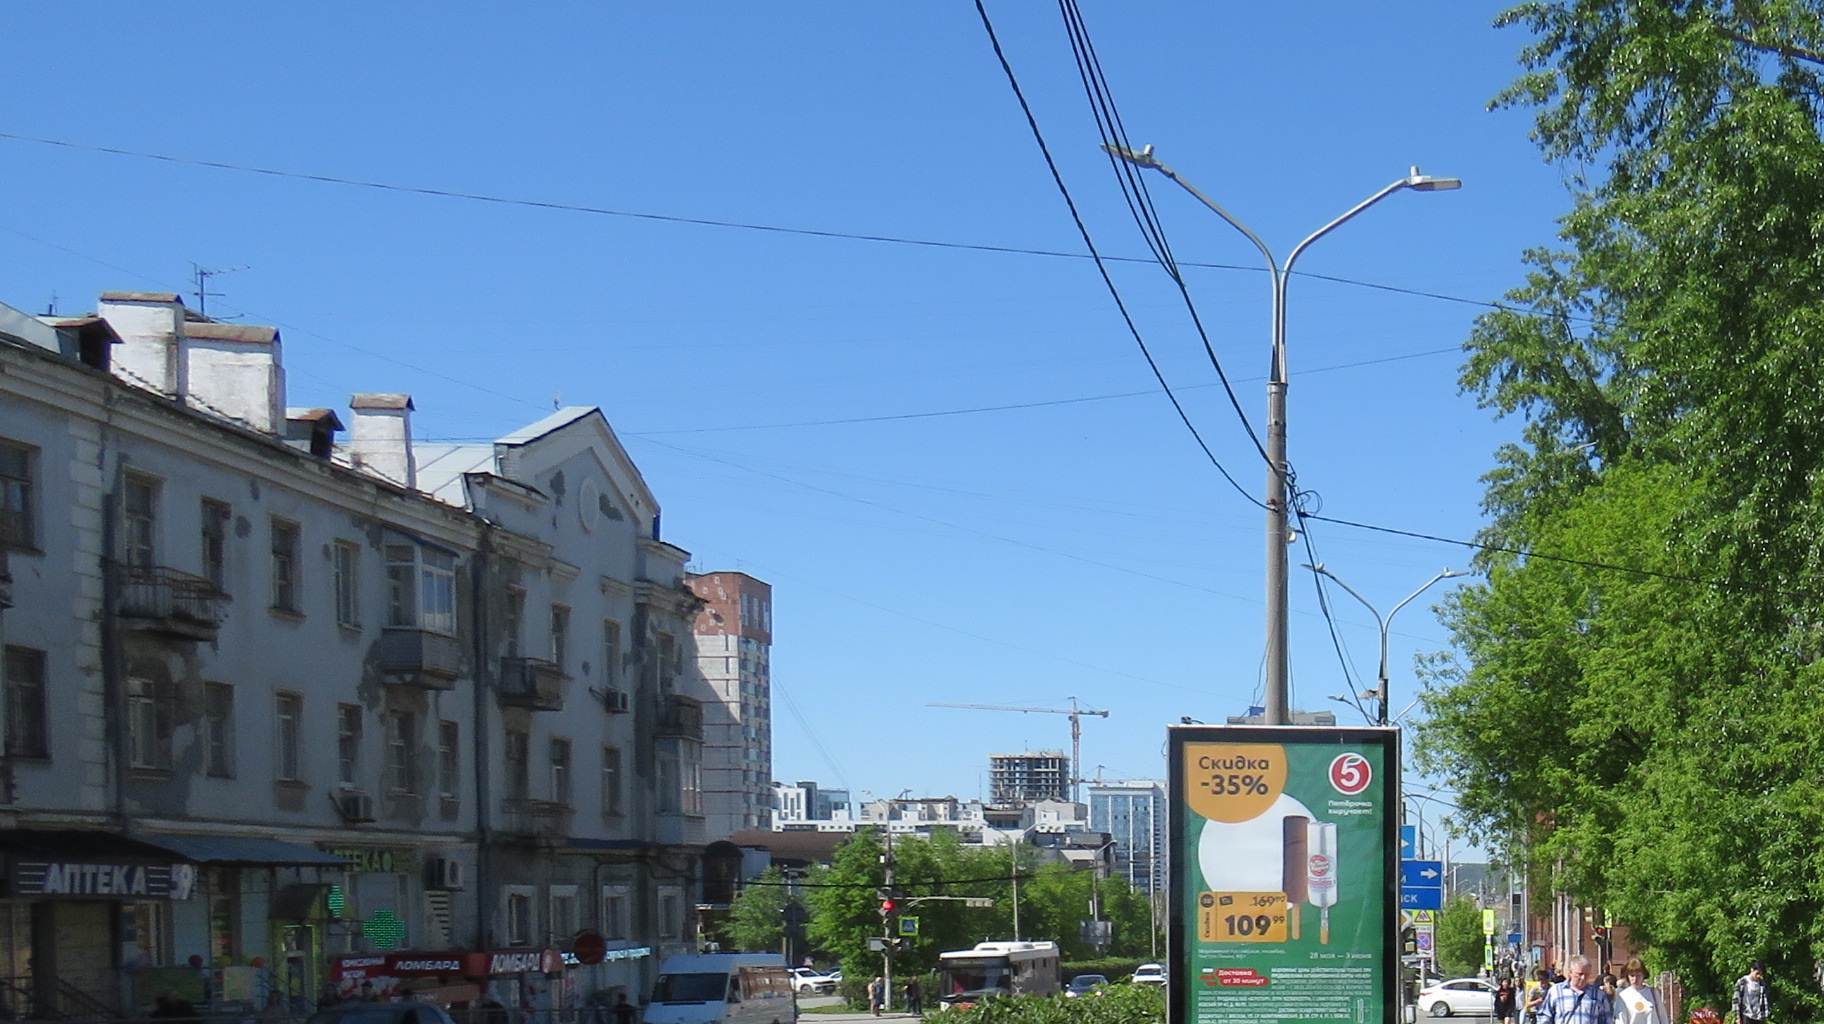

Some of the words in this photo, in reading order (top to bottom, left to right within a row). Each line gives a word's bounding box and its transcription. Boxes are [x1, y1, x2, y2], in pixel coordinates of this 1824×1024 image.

[1199, 756, 1269, 770] Скидка
[1200, 775, 1269, 795] -35%
[42, 863, 148, 895] АПТЕКА
[1225, 914, 1271, 936] 109
[394, 960, 461, 971] ЛОМБАРД
[489, 952, 541, 974] ЛОМБАРД
